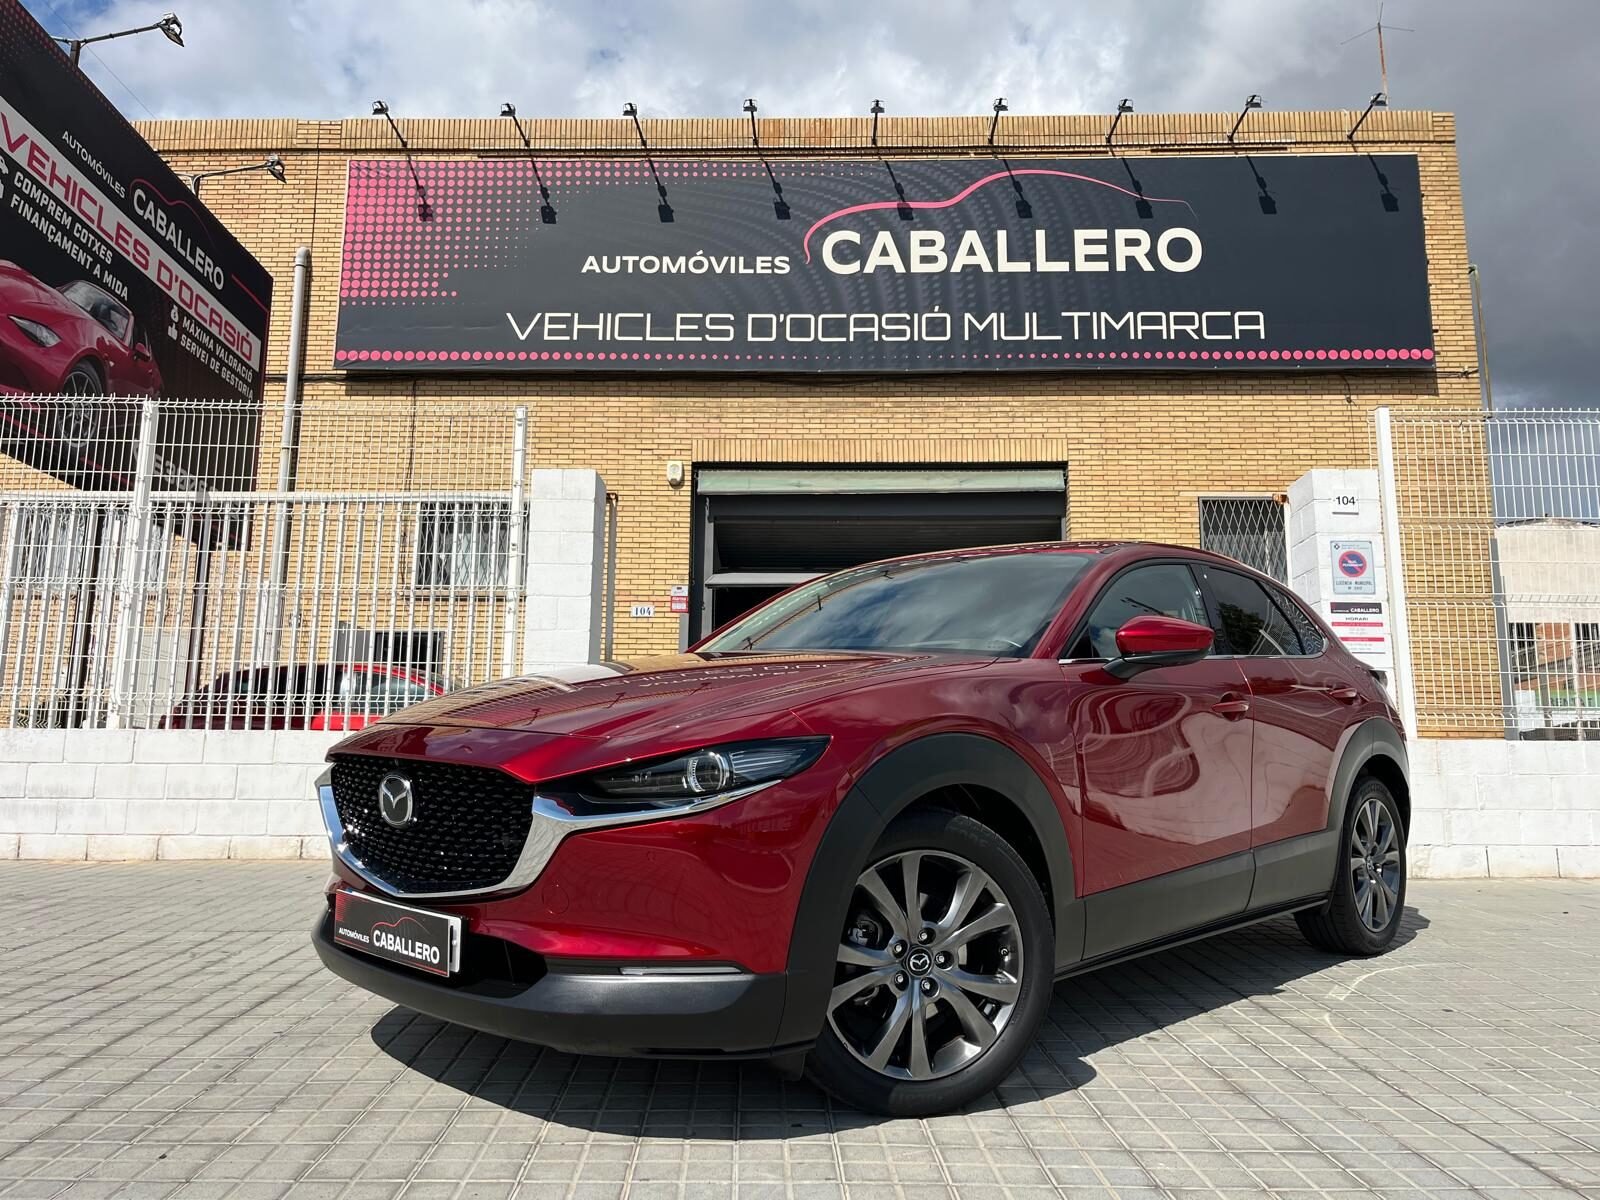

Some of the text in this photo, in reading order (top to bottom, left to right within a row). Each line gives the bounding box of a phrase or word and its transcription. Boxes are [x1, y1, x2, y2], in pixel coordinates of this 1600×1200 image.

[14, 171, 113, 265] COMPREM COTXES
[62, 131, 224, 290] AUTOMÓVILES CABALLERO
[0, 111, 252, 361] VEHICLES D'OCASIÓ
[10, 194, 128, 301] FINANÇAMENT A MIDA
[581, 227, 1203, 275] AUTOMÓVILES CABALLERO
[506, 305, 1265, 342] VEHICLES D'OCASIÓ MULTIMARCA
[180, 334, 209, 365] SERVEI
[210, 357, 220, 374] DE
[215, 343, 253, 383] VALORACIÓ
[1336, 496, 1356, 505] 104
[635, 607, 651, 616] 104
[338, 927, 440, 964] AUTOMÓVILES CABALLERO
